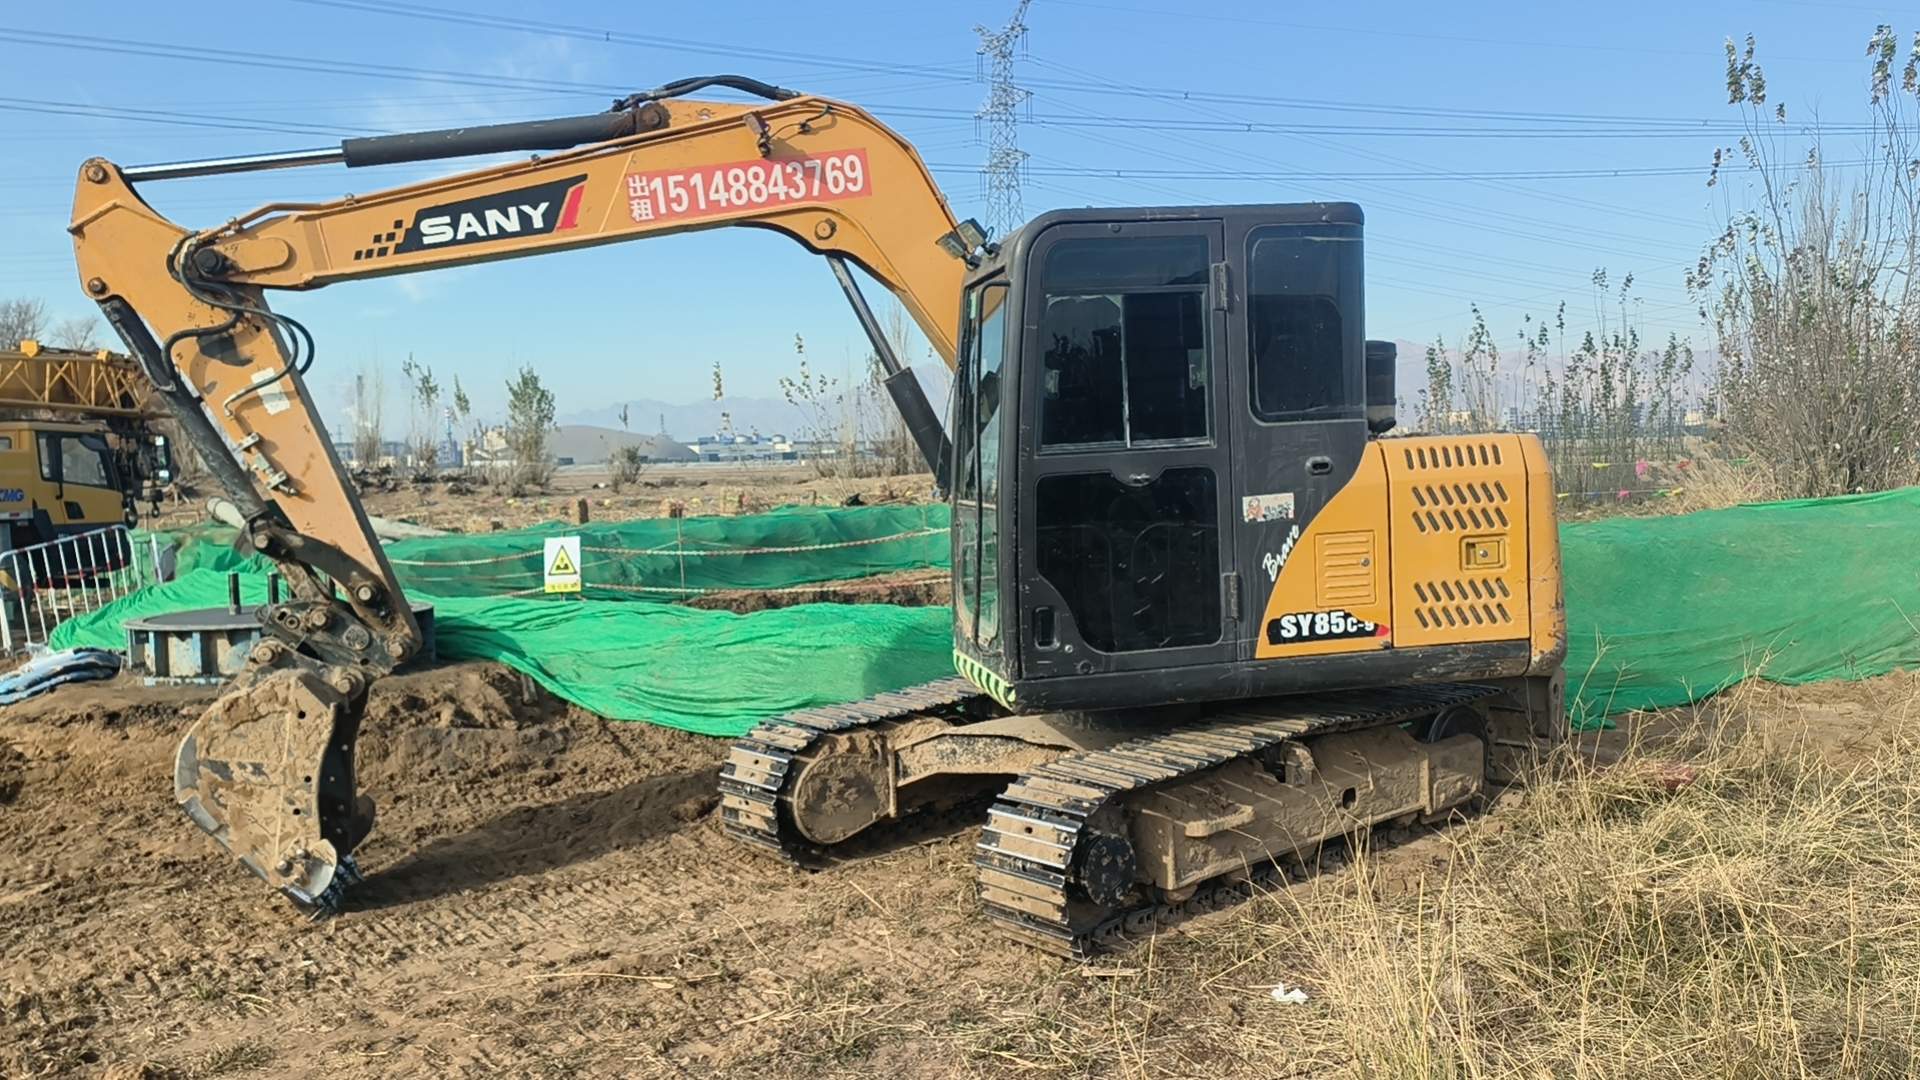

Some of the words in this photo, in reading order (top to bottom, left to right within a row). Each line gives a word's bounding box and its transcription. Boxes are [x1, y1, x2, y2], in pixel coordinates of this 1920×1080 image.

[628, 174, 655, 222] 出租
[649, 154, 864, 215] 15148843769
[419, 202, 550, 245] SANY
[1262, 525, 1299, 582] Bravo
